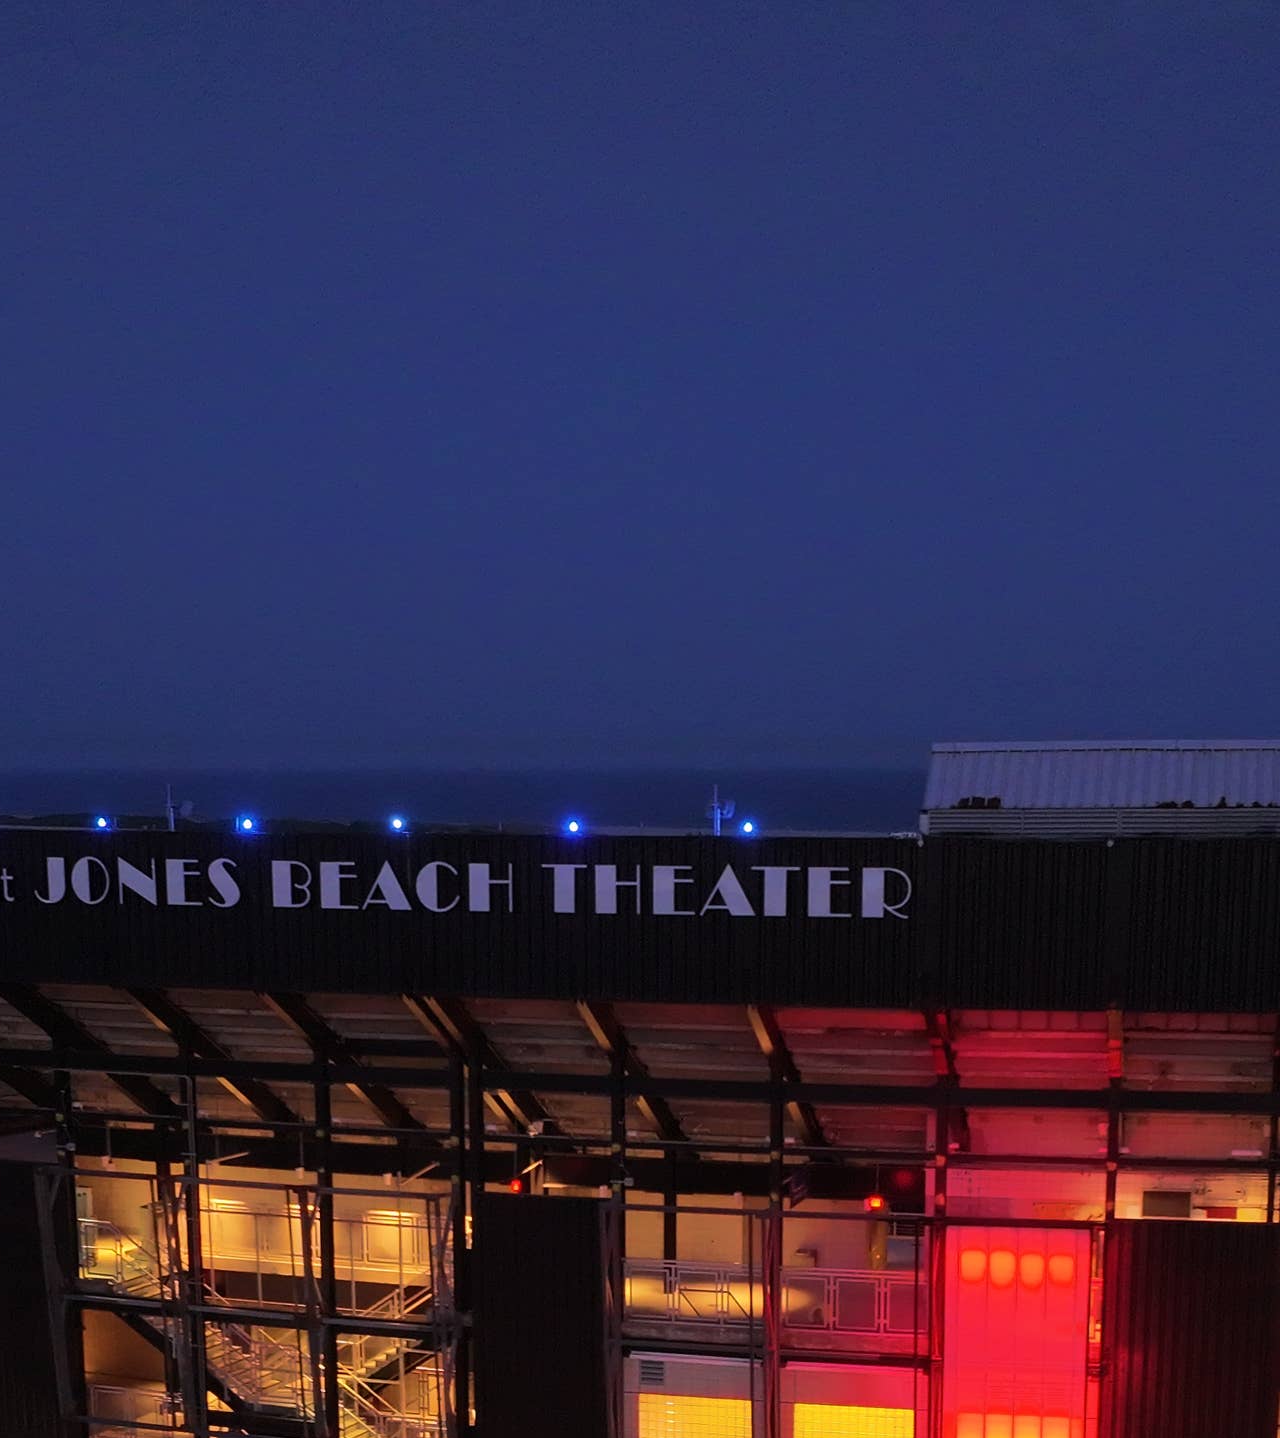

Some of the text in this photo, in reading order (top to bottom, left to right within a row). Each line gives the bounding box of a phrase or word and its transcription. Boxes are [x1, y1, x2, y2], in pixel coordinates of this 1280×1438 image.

[34, 856, 241, 908] JONES
[271, 860, 513, 913] BEACH
[541, 863, 912, 919] THEATER
